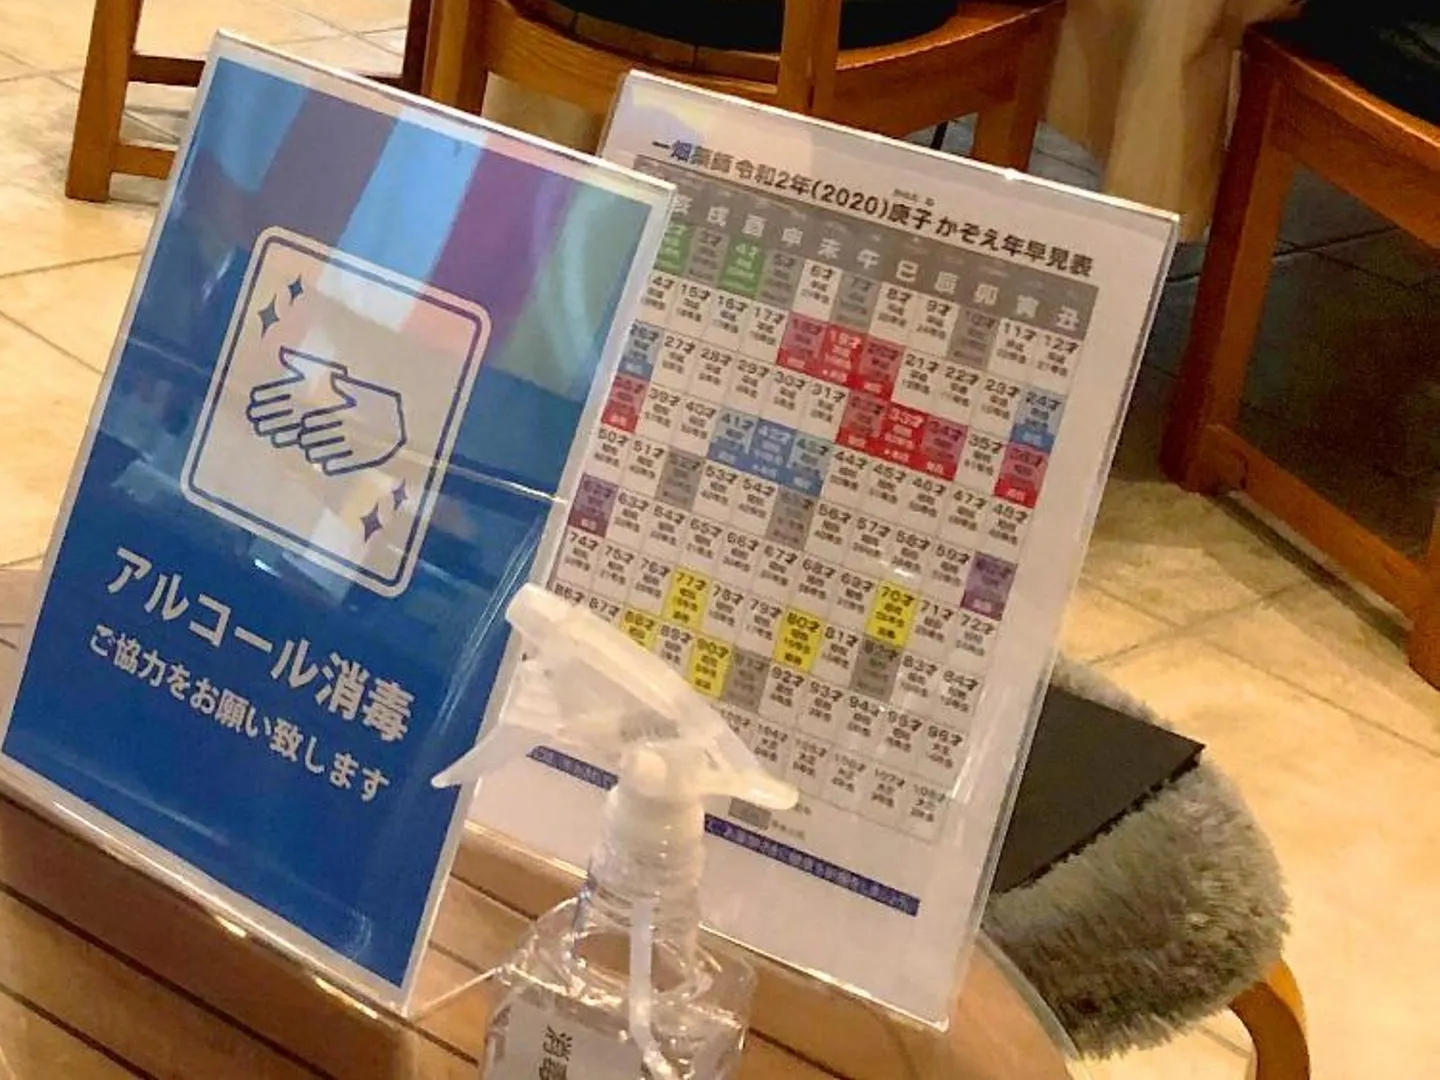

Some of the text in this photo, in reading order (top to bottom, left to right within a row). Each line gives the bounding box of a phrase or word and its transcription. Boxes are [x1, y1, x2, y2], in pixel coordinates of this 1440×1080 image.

[809, 263, 833, 281] 6才
[885, 286, 912, 306] 8才
[925, 298, 952, 318] 9才
[1002, 321, 1038, 343] 11才
[1042, 333, 1080, 356] 12才
[816, 236, 842, 261] 未
[853, 247, 880, 272] 午
[971, 281, 999, 307] 卯
[1053, 305, 1082, 332] 丑
[649, 274, 675, 290] 4才
[679, 283, 711, 302] 15才
[716, 294, 748, 313] 16才
[753, 306, 785, 325] 17才
[904, 353, 939, 374] 21才
[944, 366, 980, 387] 22才
[984, 378, 1021, 399] 23才
[663, 334, 696, 355] 27才
[699, 346, 733, 367] 28才
[735, 358, 770, 379] 29才
[855, 515, 892, 539] 57才
[568, 531, 599, 552] 74才
[603, 544, 635, 566] 75才
[638, 556, 672, 579] 76才
[674, 570, 708, 593] 77才
[710, 582, 745, 606] 78才
[823, 624, 859, 649] 81才
[878, 584, 915, 608] 70才
[918, 598, 955, 623] 71才
[958, 612, 997, 637] 72才
[107, 545, 415, 741] アルコール消毒
[587, 595, 620, 619] 87才
[769, 664, 806, 689] 92才
[90, 624, 390, 801] ご協力をお願い致します
